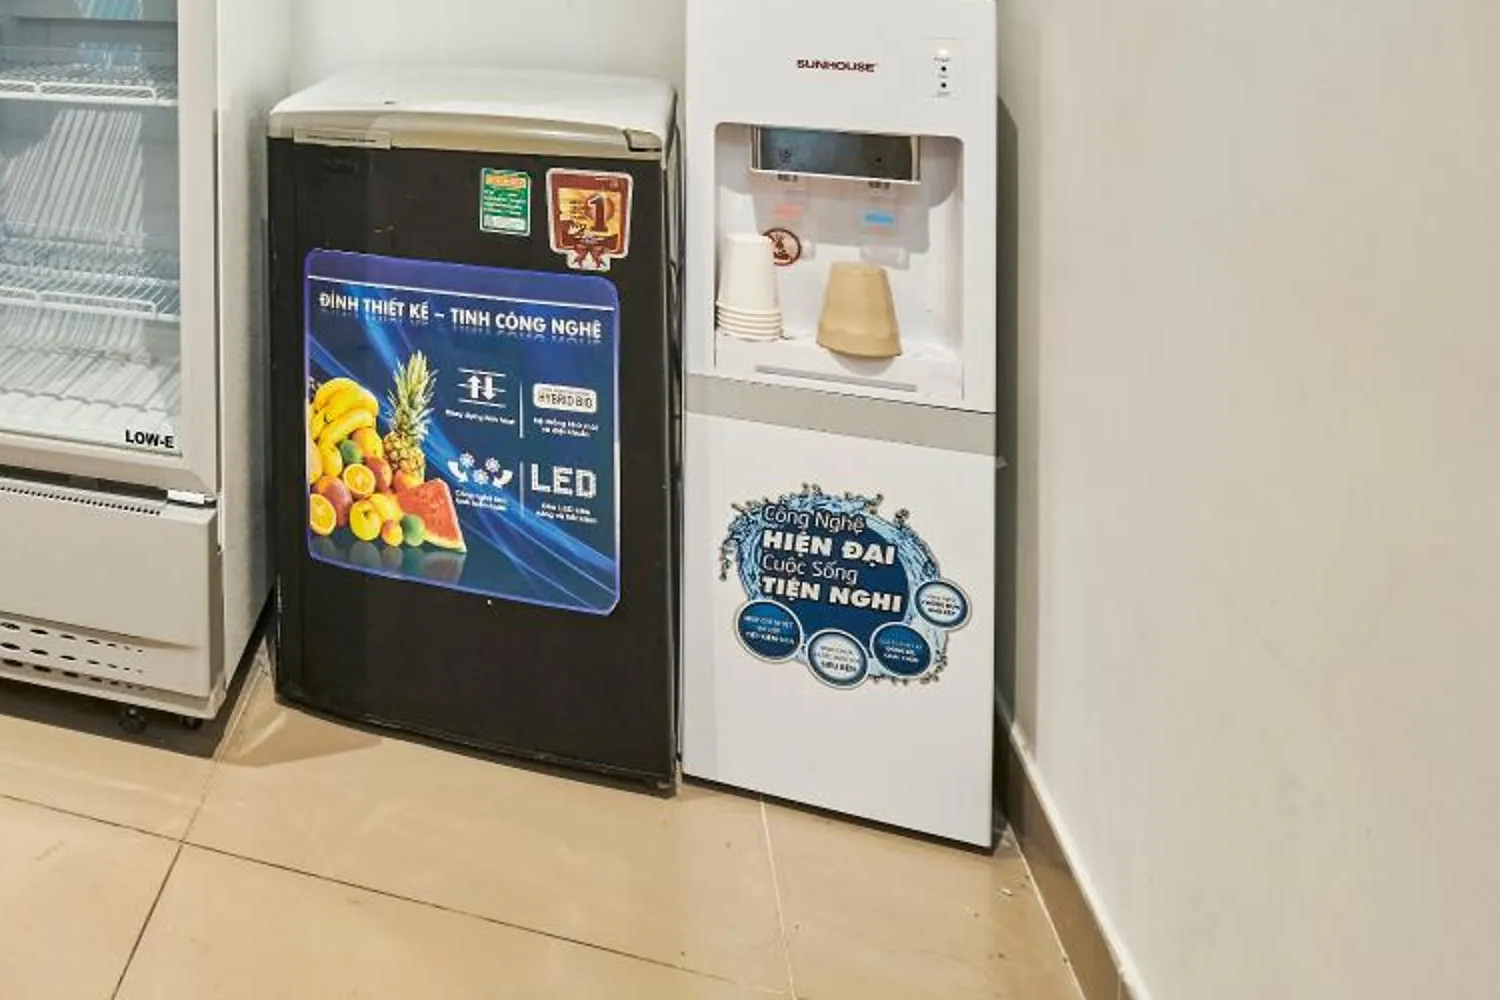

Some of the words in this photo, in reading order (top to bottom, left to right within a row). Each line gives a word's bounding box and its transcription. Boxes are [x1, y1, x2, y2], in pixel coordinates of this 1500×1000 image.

[797, 59, 876, 72] SUNHOUSE
[450, 307, 490, 327] TINH
[495, 311, 546, 333] CÔNG
[125, 429, 174, 448] LOW-E
[531, 463, 597, 499] LED
[763, 504, 810, 529] Công
[815, 511, 865, 535] Nghệ
[763, 530, 832, 557] HIỆN
[842, 540, 895, 567] ĐẠI
[763, 553, 805, 577] Cuộc
[812, 560, 858, 585] Sống
[761, 576, 820, 602] TIỆN
[829, 590, 902, 613] NGHI
